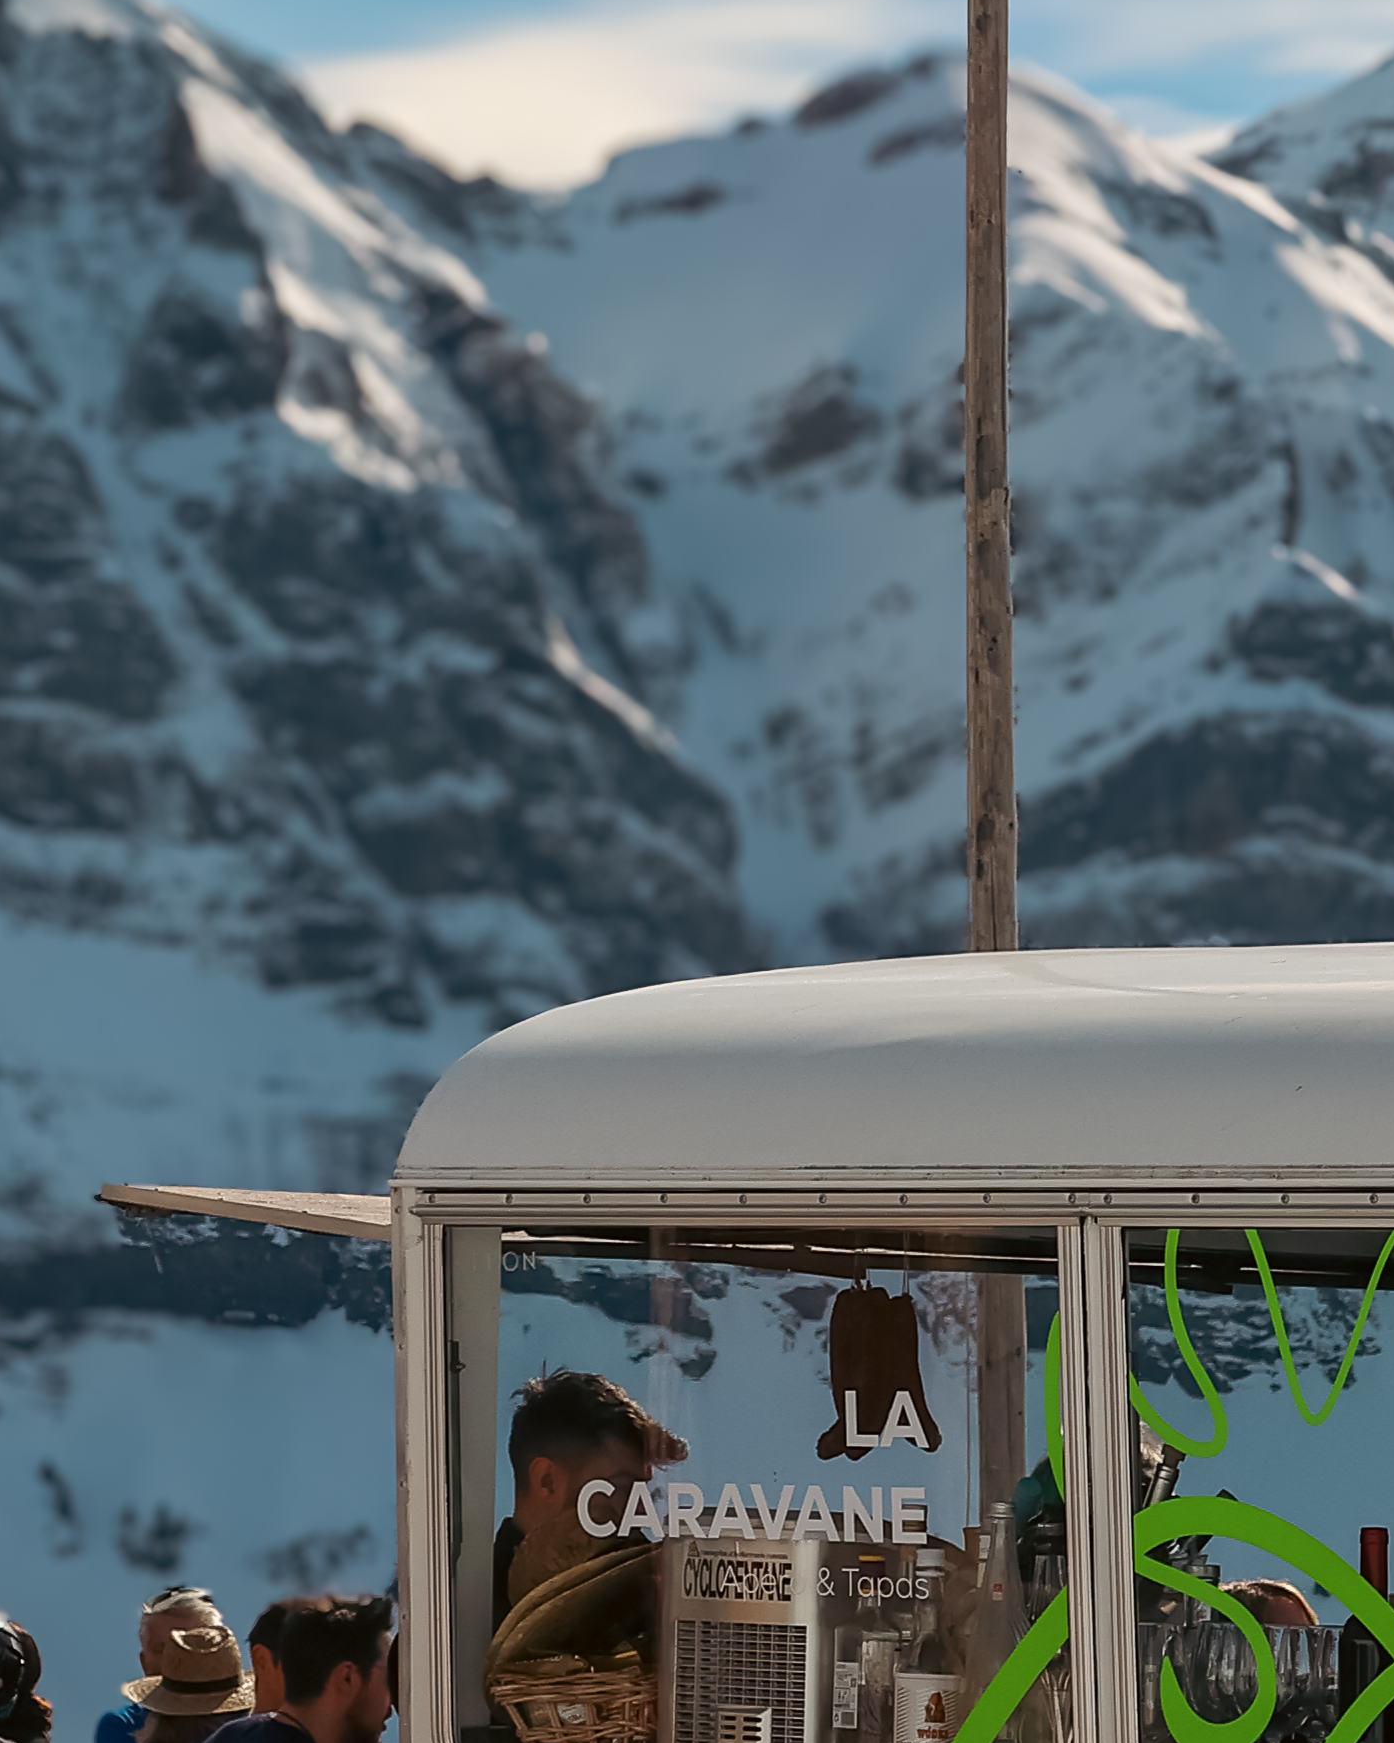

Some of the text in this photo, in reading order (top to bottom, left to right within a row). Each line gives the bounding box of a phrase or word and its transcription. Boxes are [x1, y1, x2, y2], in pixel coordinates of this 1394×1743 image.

[844, 1390, 930, 1448] LA
[576, 1479, 928, 1545] CARAVANE
[816, 1567, 836, 1597] &
[841, 1567, 930, 1607] Tapas
